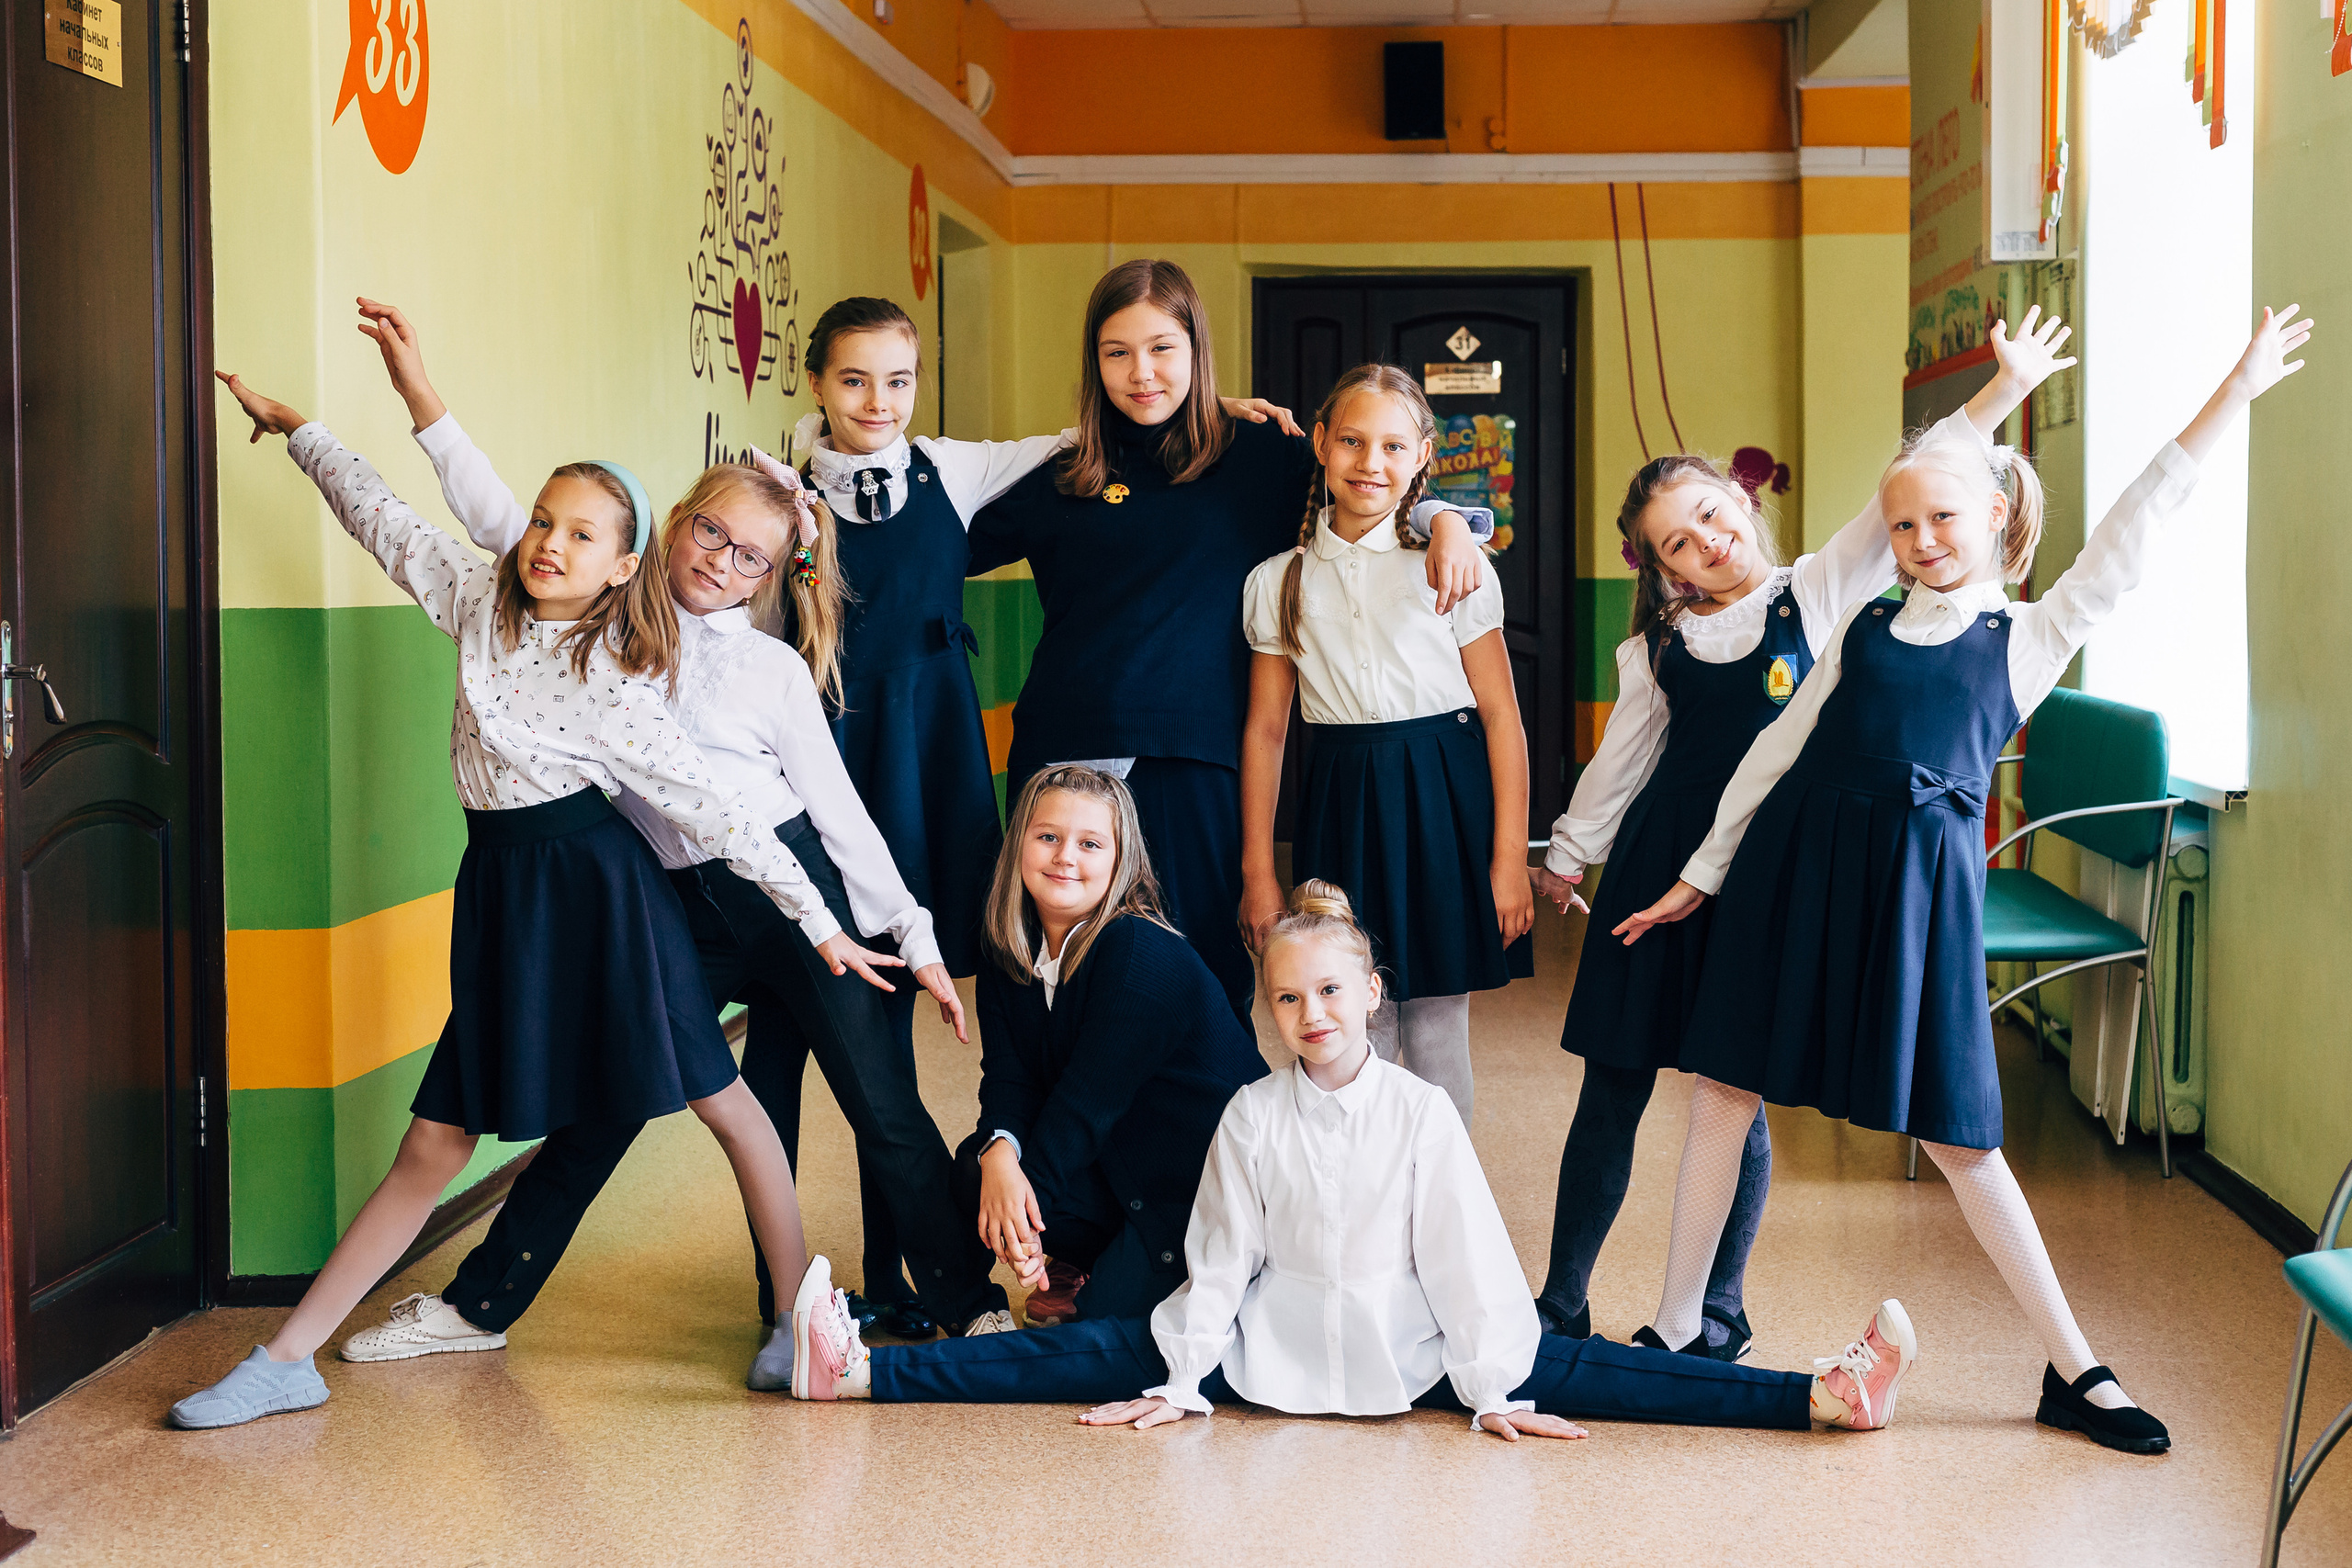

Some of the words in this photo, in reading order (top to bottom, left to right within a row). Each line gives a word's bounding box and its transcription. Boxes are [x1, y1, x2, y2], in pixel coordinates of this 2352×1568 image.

[59, 18, 108, 51] начальных
[67, 46, 103, 73] классов
[365, 0, 421, 107] 33
[1455, 334, 1470, 350] 31
